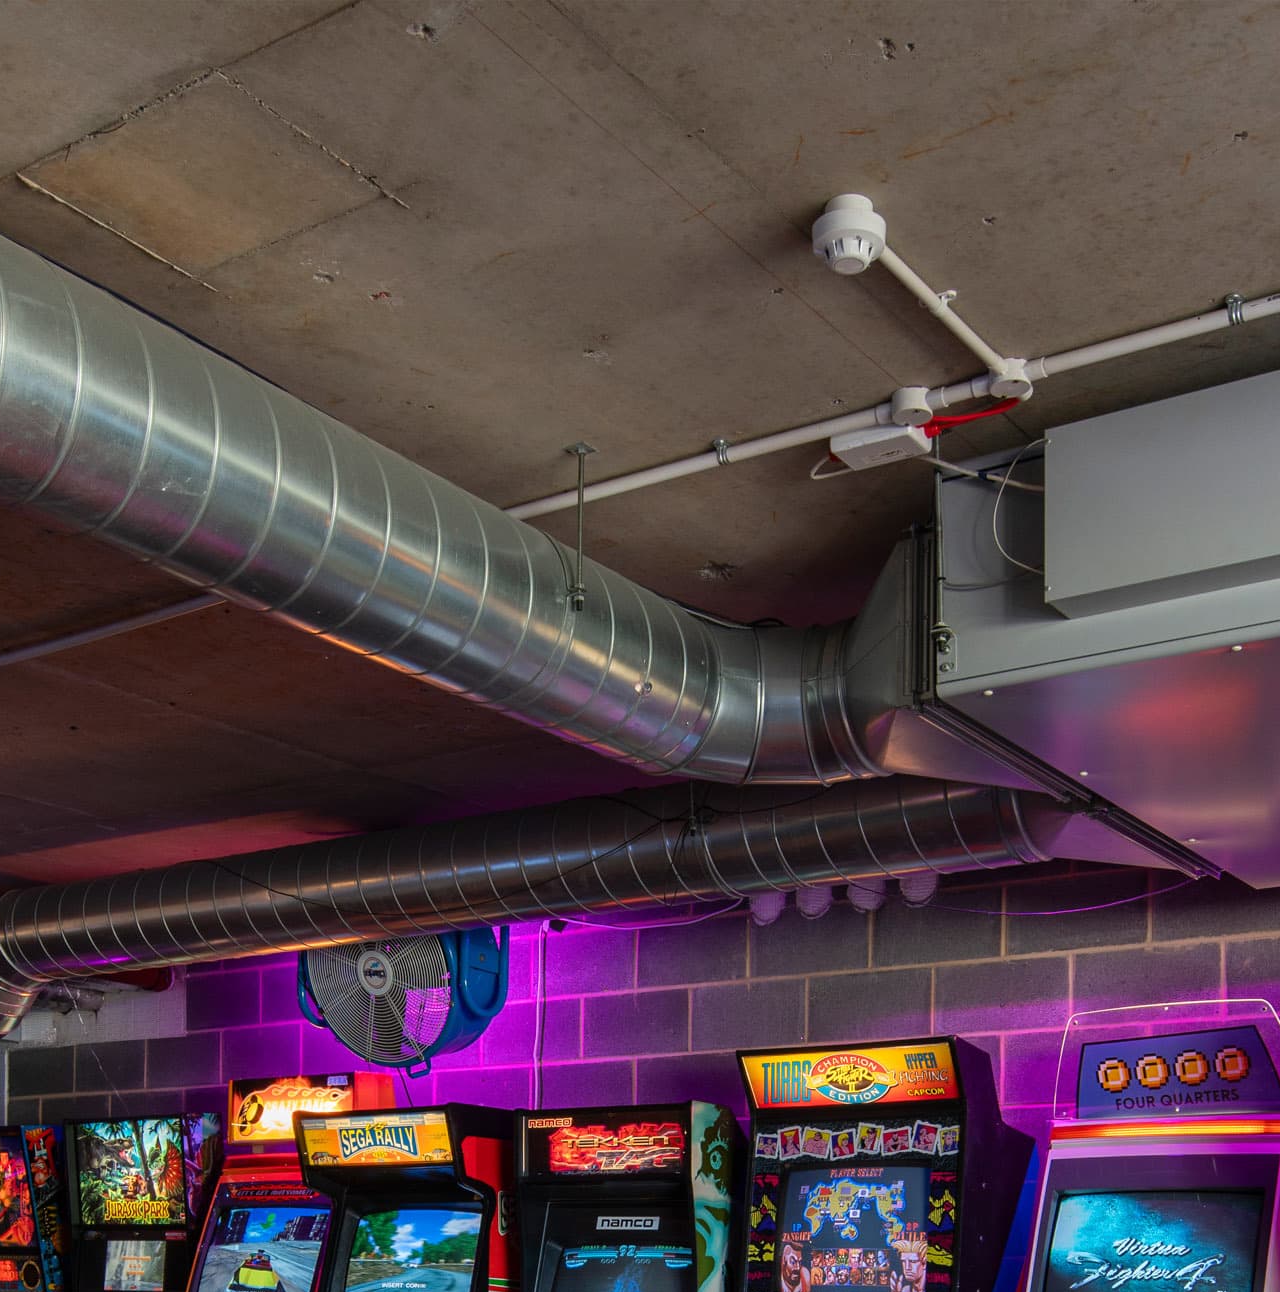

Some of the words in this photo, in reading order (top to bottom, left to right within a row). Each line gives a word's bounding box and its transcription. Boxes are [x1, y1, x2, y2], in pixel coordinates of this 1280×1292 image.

[817, 1055, 878, 1073] CHAMPION
[904, 1051, 937, 1070] HYPER
[761, 1060, 812, 1105] TURBO
[898, 1069, 949, 1085] FIGHTING
[828, 1087, 880, 1102] EDITION
[907, 1087, 945, 1097] CAPCOM
[1115, 1095, 1156, 1111] FOUR
[1160, 1089, 1240, 1106] QUARTERS
[528, 1117, 573, 1129] namco
[340, 1128, 375, 1156] SEGA
[375, 1126, 414, 1153] RALLY
[560, 1135, 670, 1149] TEKKEN
[830, 1168, 856, 1178] PLAYER
[857, 1168, 884, 1177] SELECT
[104, 1200, 141, 1220] JURASSIC
[142, 1199, 170, 1219] PARK
[600, 1217, 655, 1229] namco
[792, 1223, 803, 1231] 1P
[781, 1231, 813, 1242] ZANGIEF
[1112, 1236, 1192, 1257] Virtua
[1066, 1251, 1178, 1289] Fighter
[1176, 1253, 1225, 1291] 4
